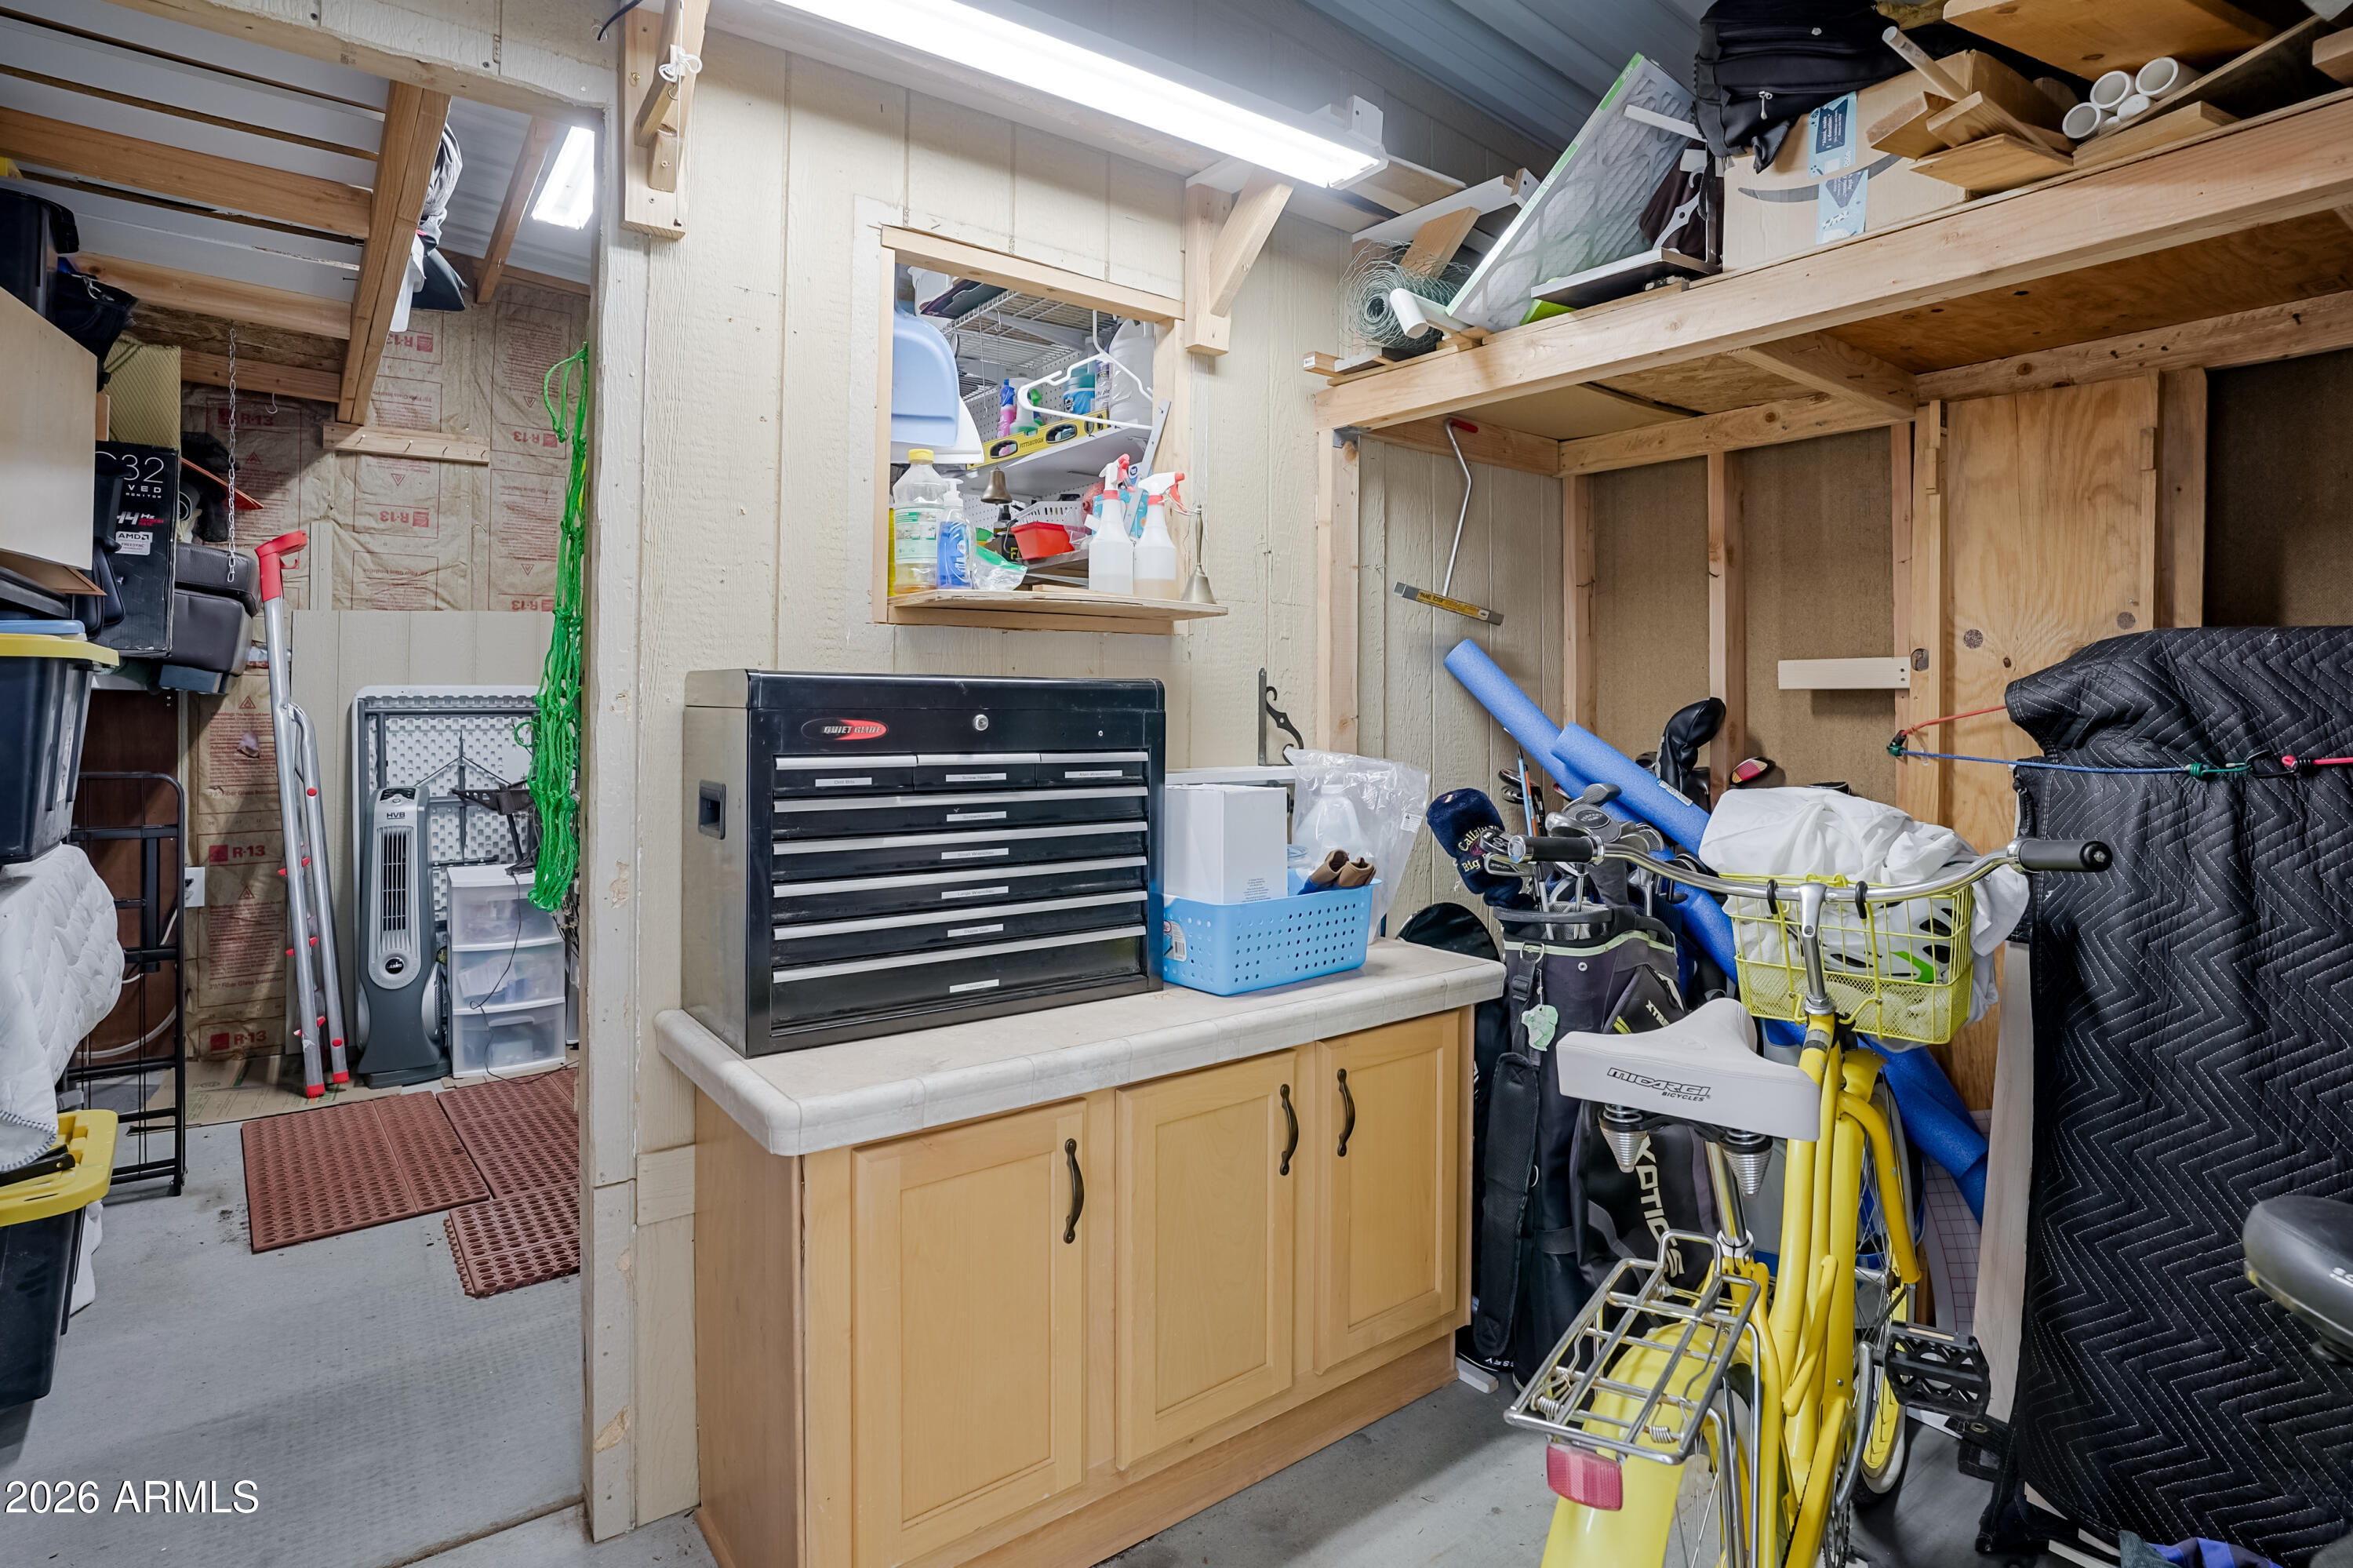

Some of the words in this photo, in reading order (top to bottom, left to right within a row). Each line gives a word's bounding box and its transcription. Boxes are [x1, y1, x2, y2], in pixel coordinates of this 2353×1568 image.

[1020, 437, 1044, 448] PITTSBURGH
[128, 484, 162, 493] VED
[380, 511, 409, 523] R-13
[823, 726, 853, 734] QUIET
[854, 726, 882, 734] GLIDE
[232, 845, 266, 858] R-13
[1461, 859, 1481, 872] Big
[234, 1030, 267, 1045] R-13
[1607, 1067, 1711, 1097] MICARGI
[1661, 1091, 1705, 1102] BICYCLES
[1635, 1134, 1686, 1278] XOTICS
